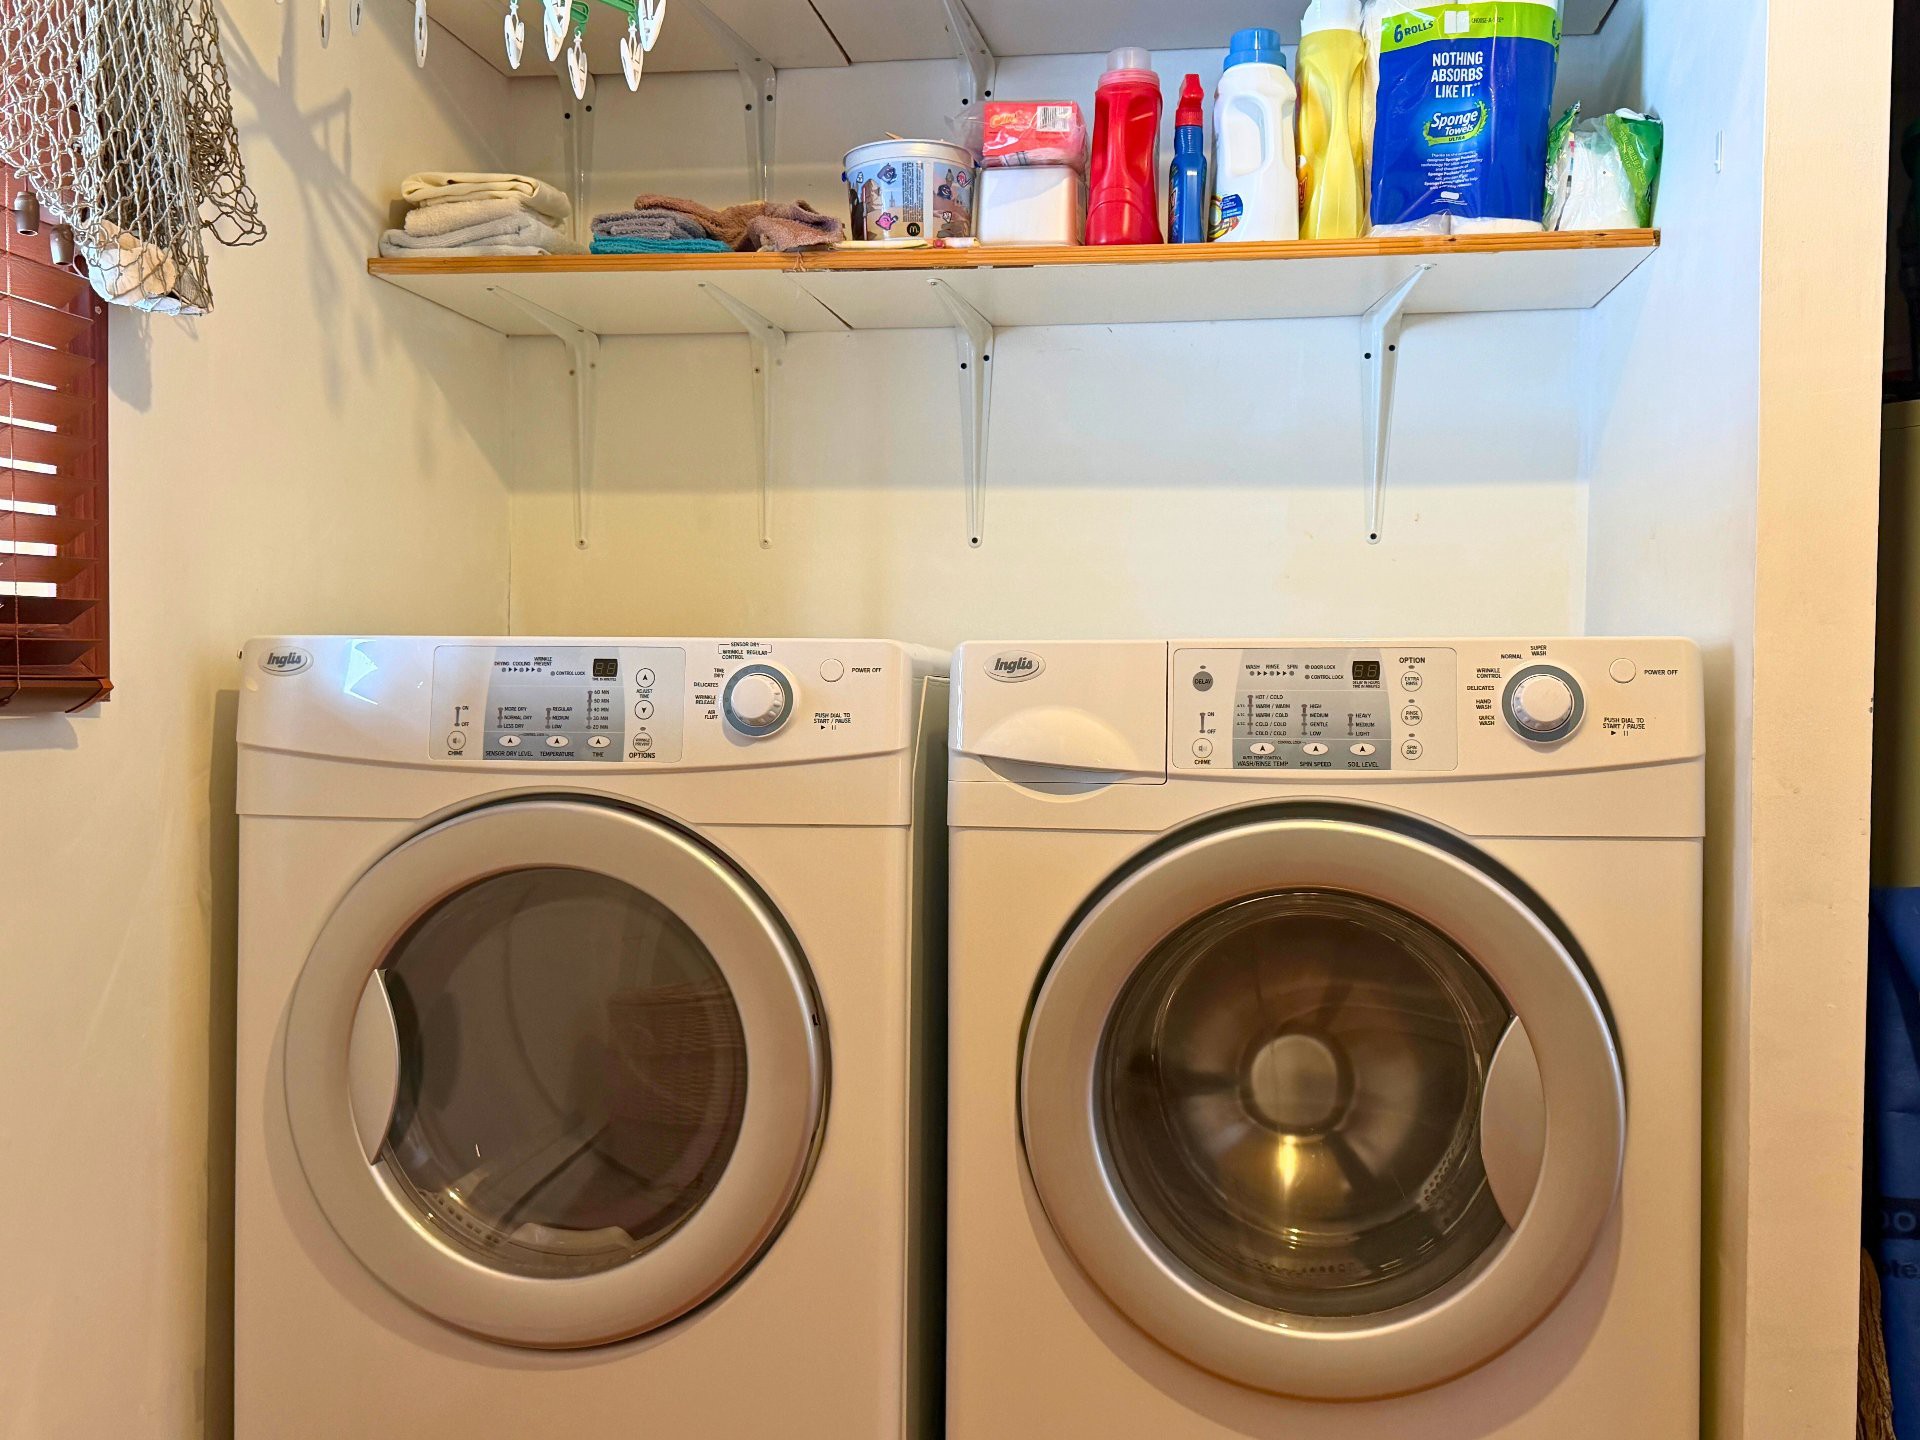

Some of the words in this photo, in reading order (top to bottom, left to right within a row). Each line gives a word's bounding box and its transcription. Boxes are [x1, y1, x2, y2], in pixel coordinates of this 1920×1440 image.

[1394, 24, 1403, 43] 6
[1404, 20, 1434, 36] ROLLS
[1432, 51, 1484, 67] NOTHING
[1431, 66, 1484, 83] ABSORBS
[1435, 84, 1459, 99] LIKE
[1431, 111, 1479, 130] Sponge
[1445, 123, 1474, 136] Towels
[267, 652, 302, 668] Inglis
[994, 656, 1033, 674] Inglis
